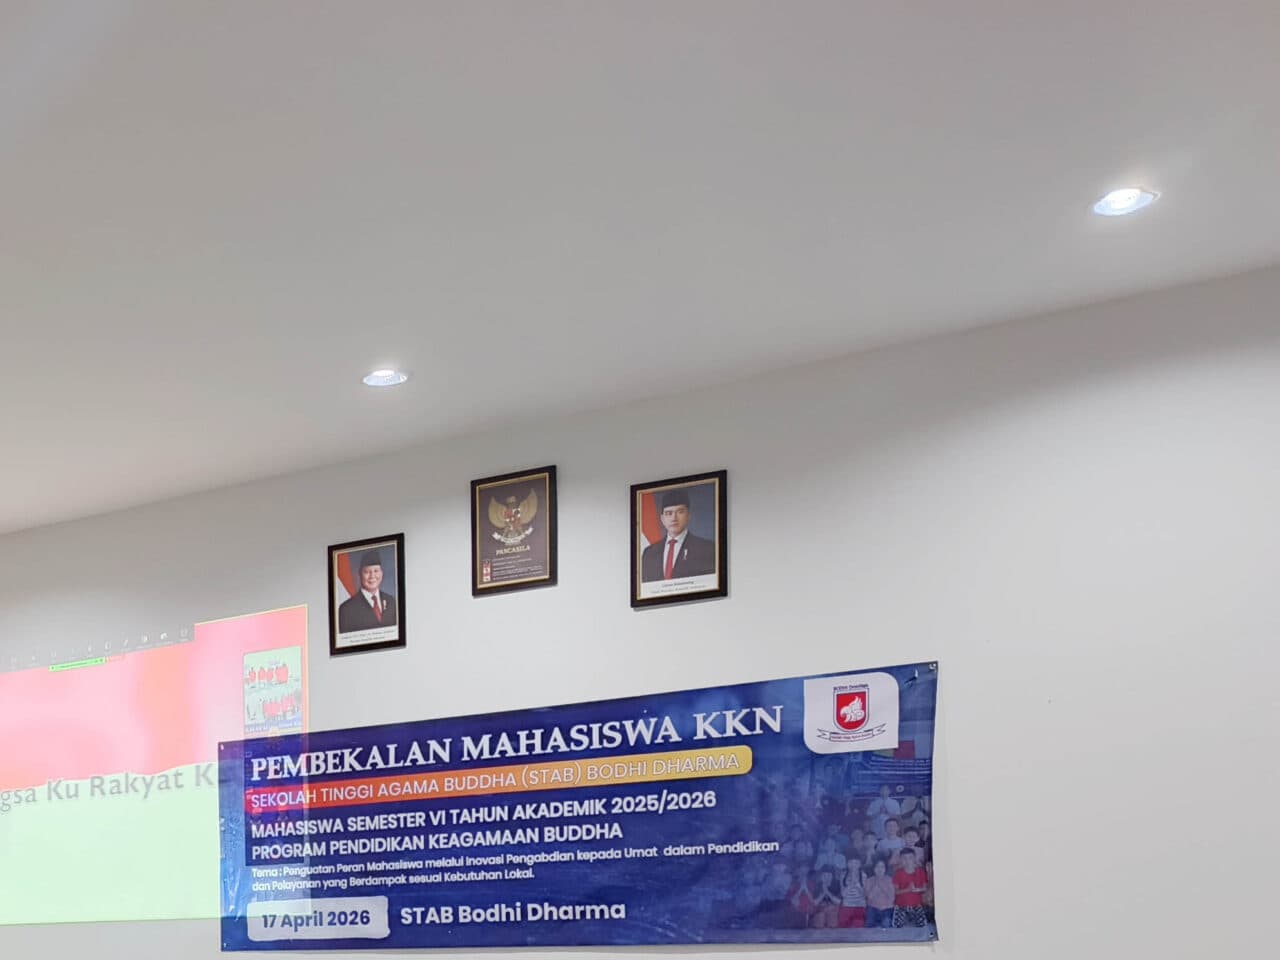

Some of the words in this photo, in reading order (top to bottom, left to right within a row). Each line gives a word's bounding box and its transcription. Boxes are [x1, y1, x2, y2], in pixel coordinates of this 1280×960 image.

[495, 545, 531, 556] PANCASILA
[250, 738, 452, 781] PEMBEKALAN
[461, 715, 682, 761] MAHASISWA
[693, 705, 784, 740] KKN
[47, 780, 80, 801] Ku
[89, 768, 184, 799] Rakyat
[195, 763, 216, 787] K
[251, 789, 317, 808] SEKOLAH
[320, 785, 374, 802] TINGGI
[377, 779, 439, 797] AGAMA
[444, 773, 517, 791] BUDDHA
[521, 761, 582, 789] (STAB)
[586, 762, 647, 780] BODHI
[652, 754, 740, 775] DHARMA
[252, 818, 344, 838] MAHASISWA
[347, 812, 426, 832] SEMESTER
[429, 810, 446, 826] VI
[449, 806, 509, 824] TAHUN
[512, 799, 607, 820] AKADEMIK
[611, 789, 717, 814] 2025/2026
[252, 842, 326, 860] PROGRAM
[330, 836, 424, 855] PENDIDIKAN
[428, 828, 539, 849] KEAGAMAAN
[544, 822, 623, 843] BUDDHA
[283, 866, 336, 878] Penguatan
[337, 864, 365, 873] Peran
[367, 859, 423, 872] Mahasiswa
[425, 856, 464, 868] melalui
[465, 854, 505, 866] Inovasi
[506, 851, 575, 866] Pengabdian
[576, 848, 622, 863] kepada
[624, 846, 658, 858] Umat
[663, 844, 705, 856] dalam
[707, 841, 780, 855] Pendidikan
[252, 882, 271, 891] dan
[272, 881, 321, 892] Pelayanan
[322, 879, 348, 890] yang
[349, 875, 407, 887] Berdampak
[409, 872, 442, 883] sesuai
[444, 869, 501, 882] Kebutuhan
[262, 913, 277, 928] 17
[281, 911, 323, 931] April
[327, 909, 371, 926] 2026
[400, 906, 454, 925] STAB
[458, 903, 522, 923] Bodhi
[527, 902, 626, 921] Dharma
